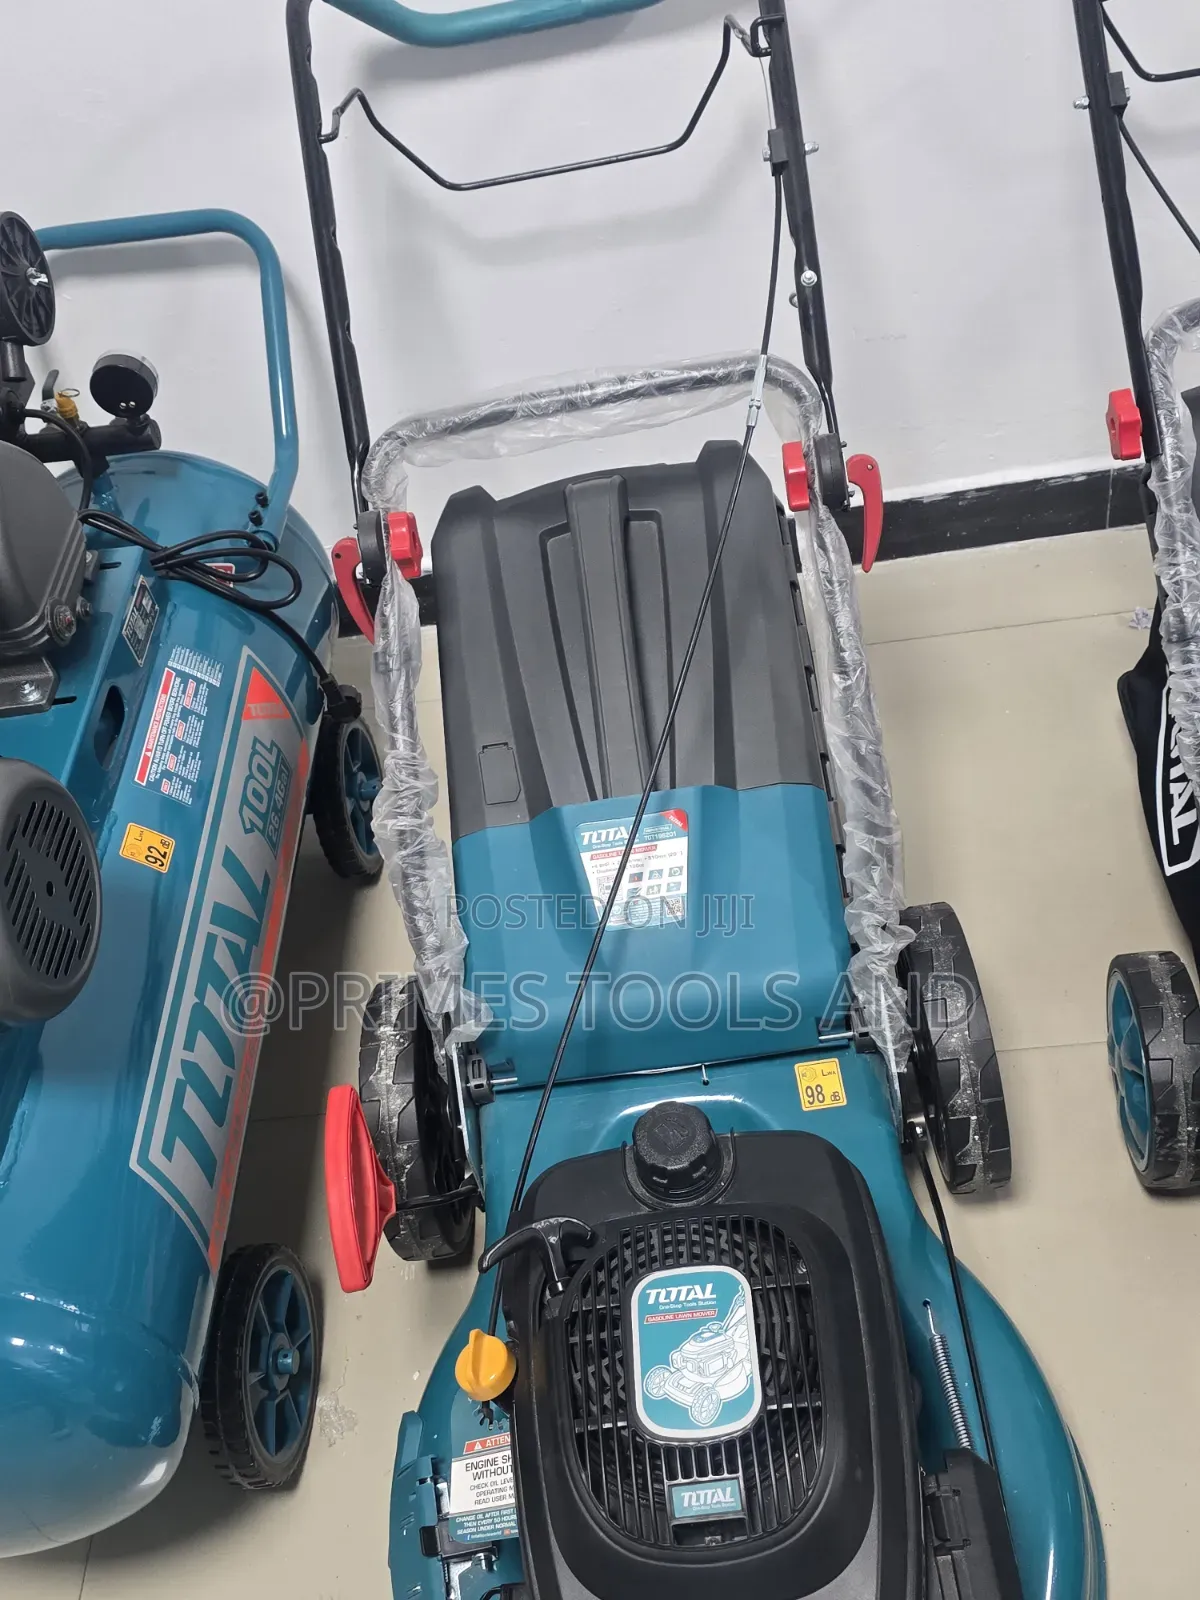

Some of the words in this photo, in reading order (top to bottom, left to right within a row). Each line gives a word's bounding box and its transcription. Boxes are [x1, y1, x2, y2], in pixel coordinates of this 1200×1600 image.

[241, 737, 280, 831] 100L
[143, 844, 168, 867] 92
[161, 845, 272, 1189] TOTAL
[805, 1084, 825, 1105] 98
[830, 1091, 841, 1102] dB
[646, 1283, 716, 1304] TOTAL
[648, 1314, 674, 1322] GASOLINE
[465, 1457, 498, 1472] ENGINE
[472, 1465, 513, 1481] WITHOUT
[470, 1482, 488, 1491] CHECK
[476, 1487, 507, 1498] OPERATING
[474, 1498, 490, 1506] READ
[492, 1495, 507, 1503] USER
[681, 1487, 734, 1507] TOTAL
[457, 1527, 476, 1535] SEASON
[477, 1524, 494, 1532] UNDER
[478, 1518, 493, 1526] EVERY
